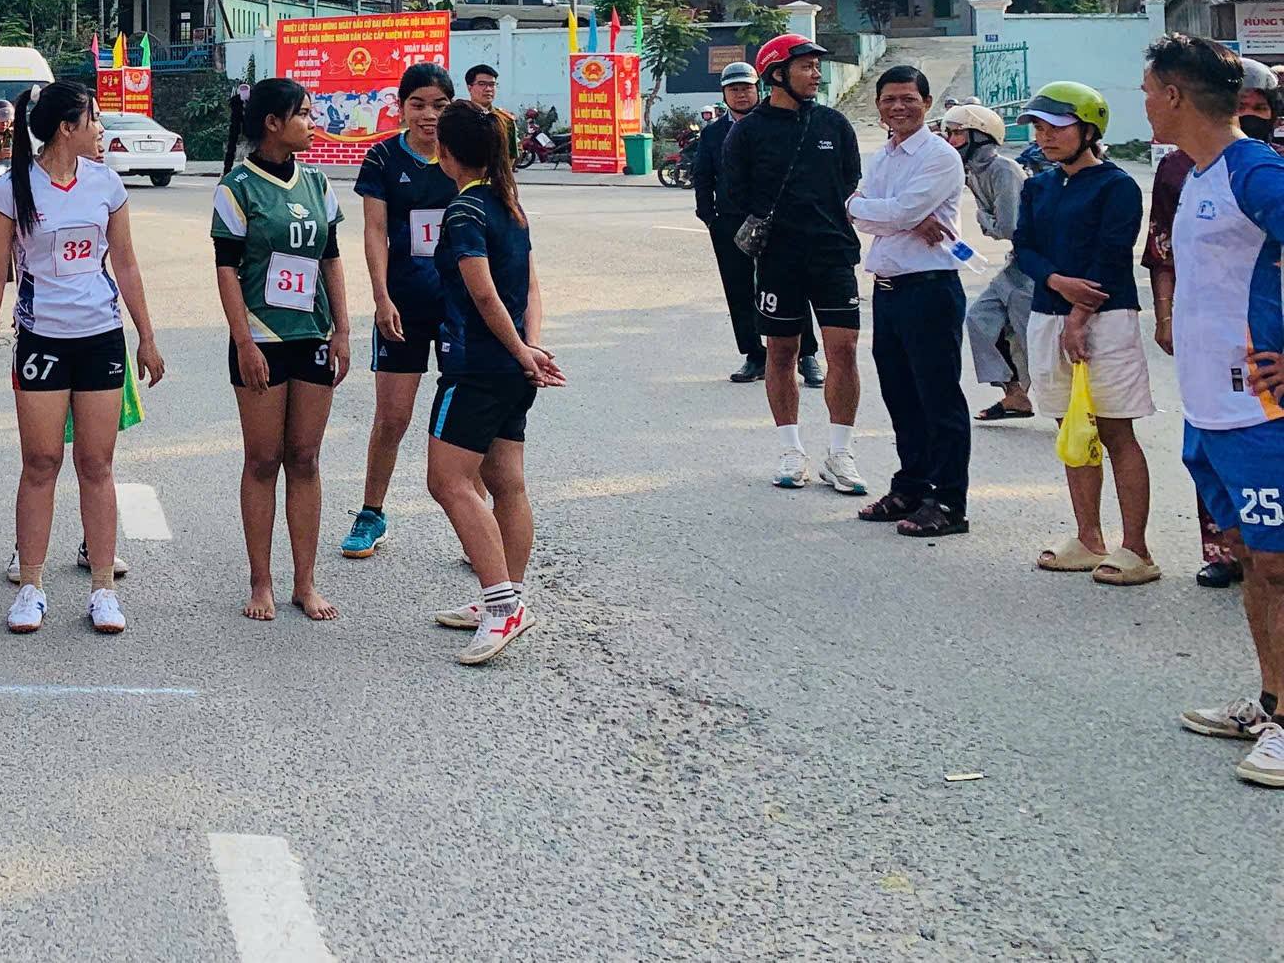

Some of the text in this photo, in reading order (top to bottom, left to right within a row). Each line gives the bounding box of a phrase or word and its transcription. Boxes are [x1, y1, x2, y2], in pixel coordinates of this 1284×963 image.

[289, 220, 318, 248] 07
[63, 239, 92, 261] 32
[277, 269, 305, 294] 31
[760, 291, 777, 313] 19
[22, 352, 60, 381] 67
[1240, 488, 1283, 526] 25
